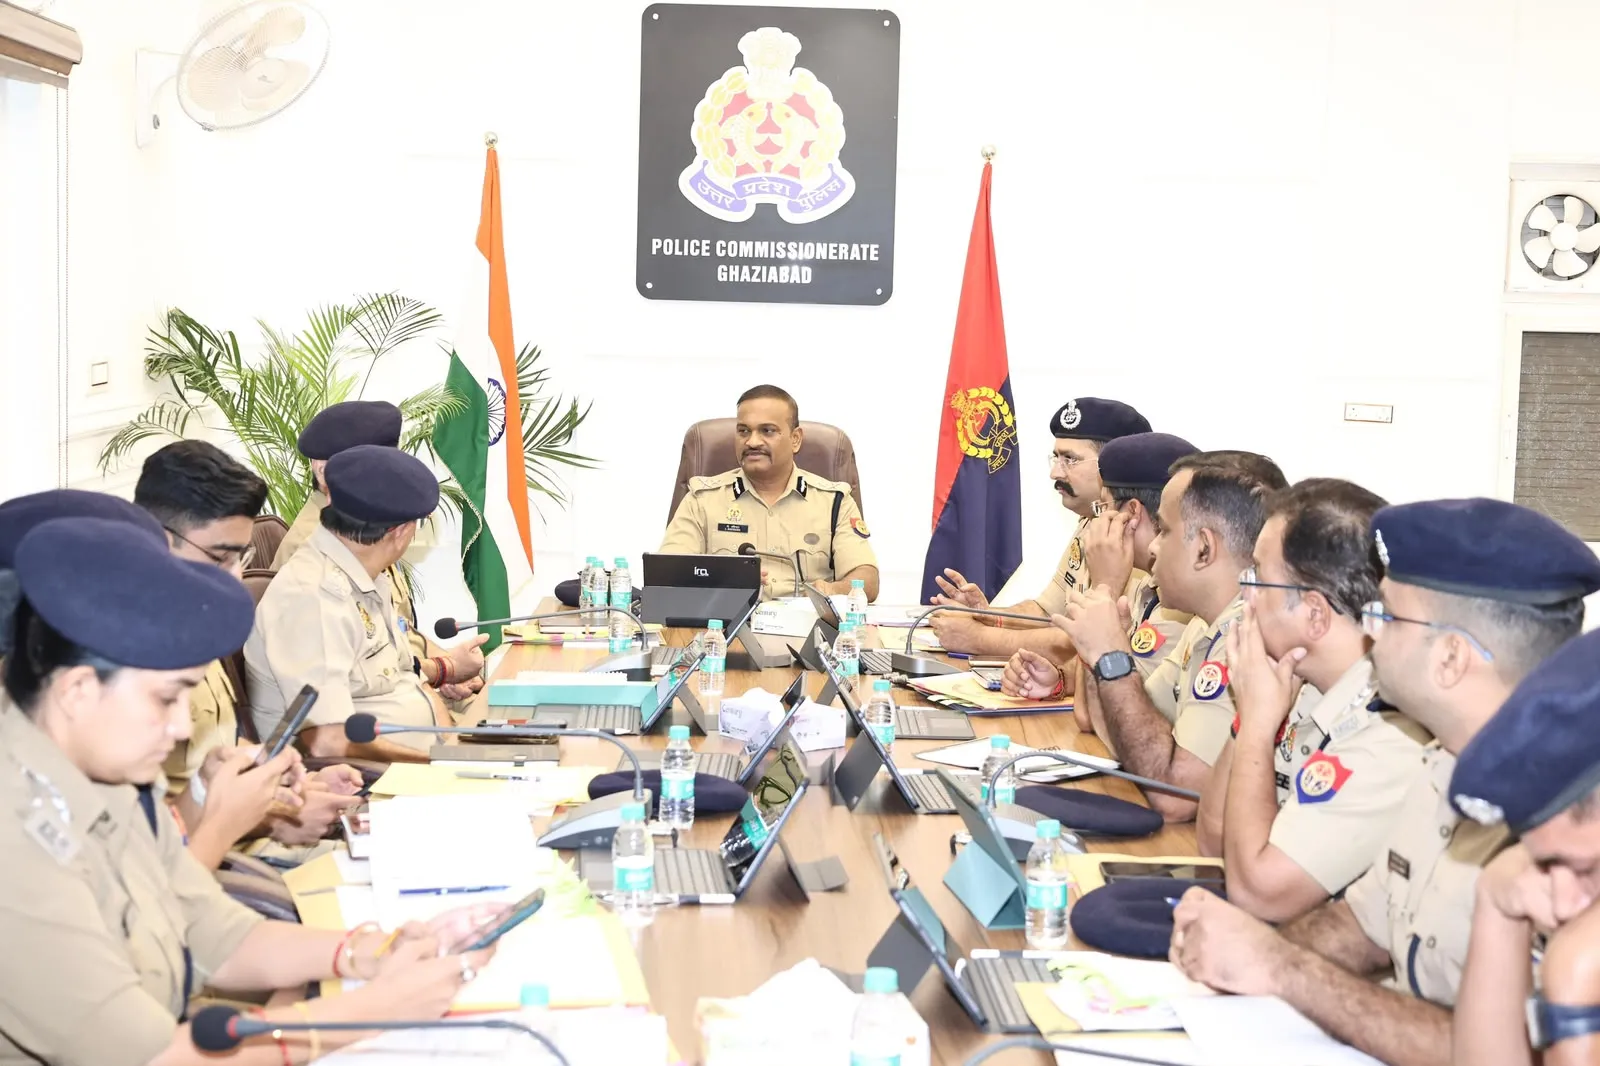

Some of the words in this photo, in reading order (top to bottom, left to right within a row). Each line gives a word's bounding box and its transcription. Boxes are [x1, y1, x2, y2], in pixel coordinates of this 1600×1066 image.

[697, 179, 736, 209] उत्तर
[741, 177, 792, 196] प्रदेश
[799, 179, 841, 212] पुलिस
[651, 238, 711, 257] POLICE
[716, 239, 880, 261] COMMISSIONERATE
[717, 264, 813, 284] GHAZIABAD
